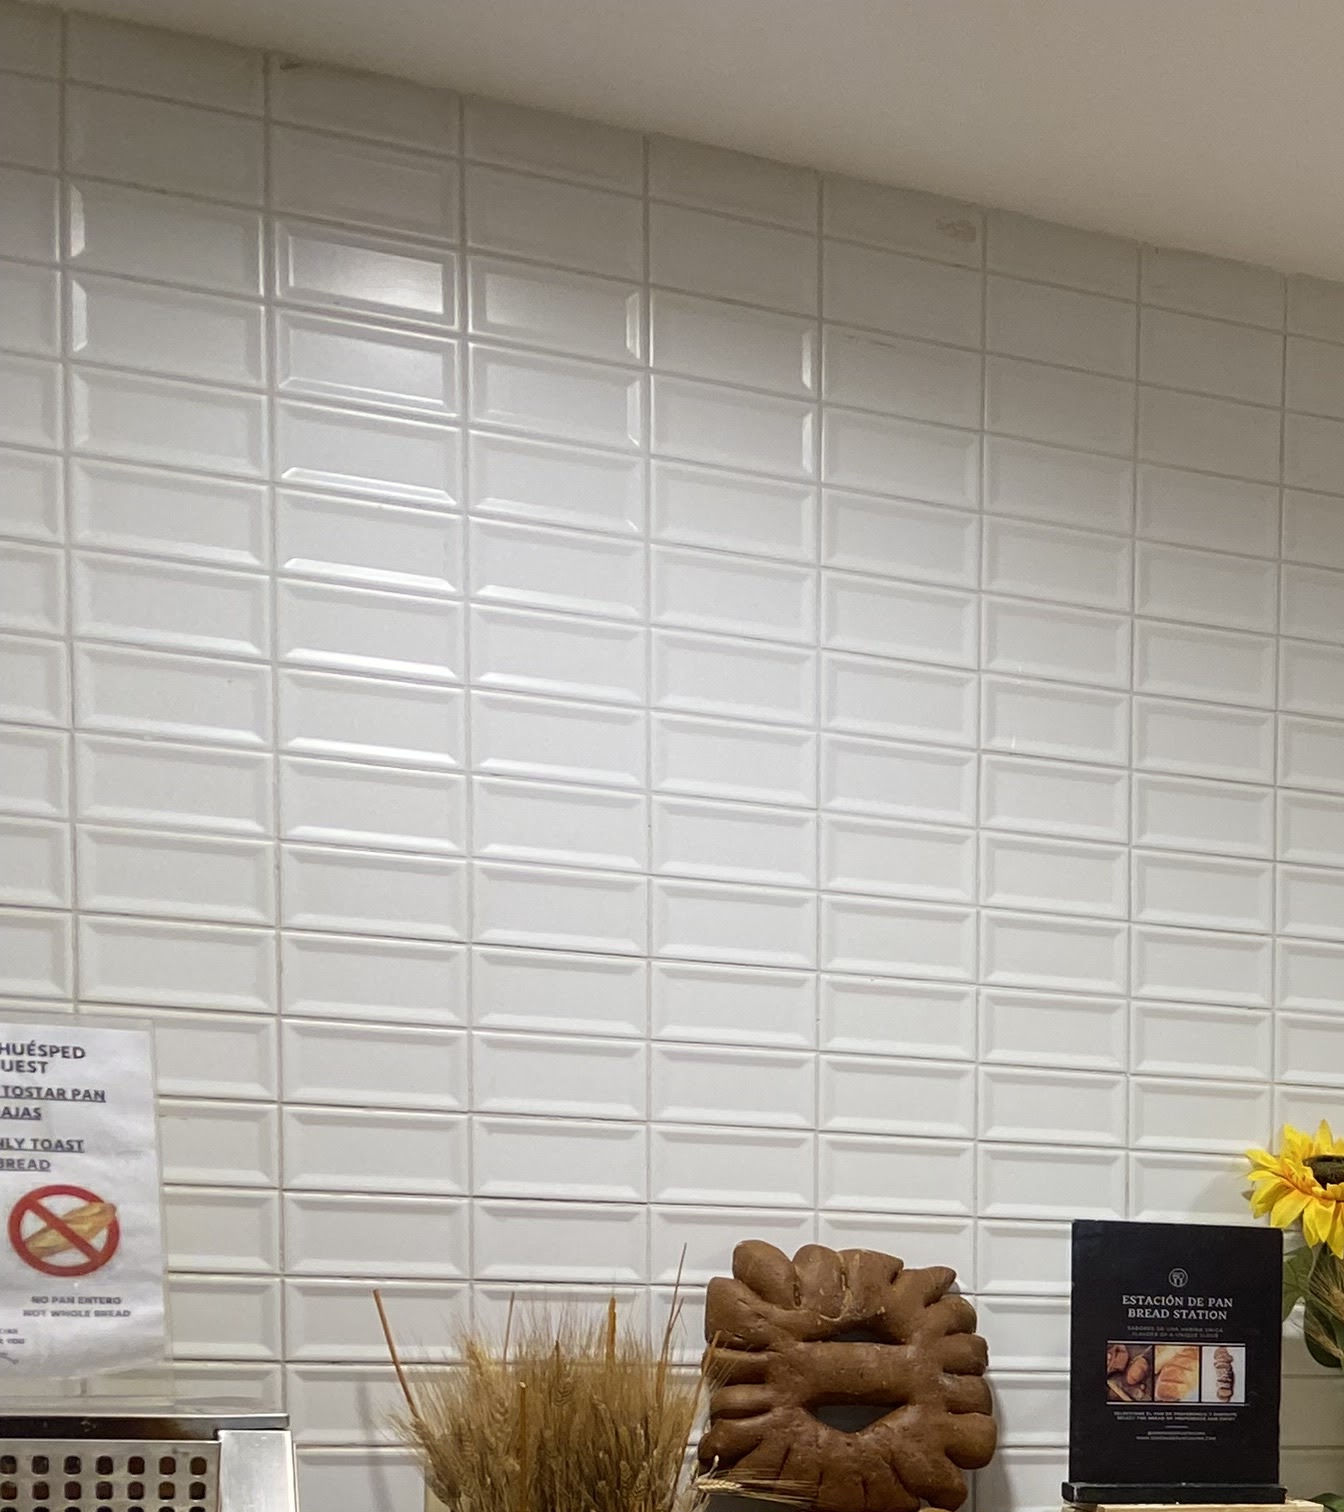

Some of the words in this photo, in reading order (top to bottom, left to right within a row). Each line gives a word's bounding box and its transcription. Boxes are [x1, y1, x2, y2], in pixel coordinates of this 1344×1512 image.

[0, 1040, 86, 1059] HUÉSPED
[2, 1085, 68, 1100] TOSTAR
[71, 1089, 106, 1103] PAN
[1, 1107, 42, 1120] AJAS
[30, 1139, 84, 1153] TOAST
[52, 1296, 75, 1304] PAN
[1122, 1294, 1183, 1306] ESTACIÓN
[1187, 1296, 1204, 1307] DE
[1208, 1298, 1233, 1308] PAN
[1127, 1308, 1170, 1319] BREAD
[1173, 1309, 1228, 1320] STATION
